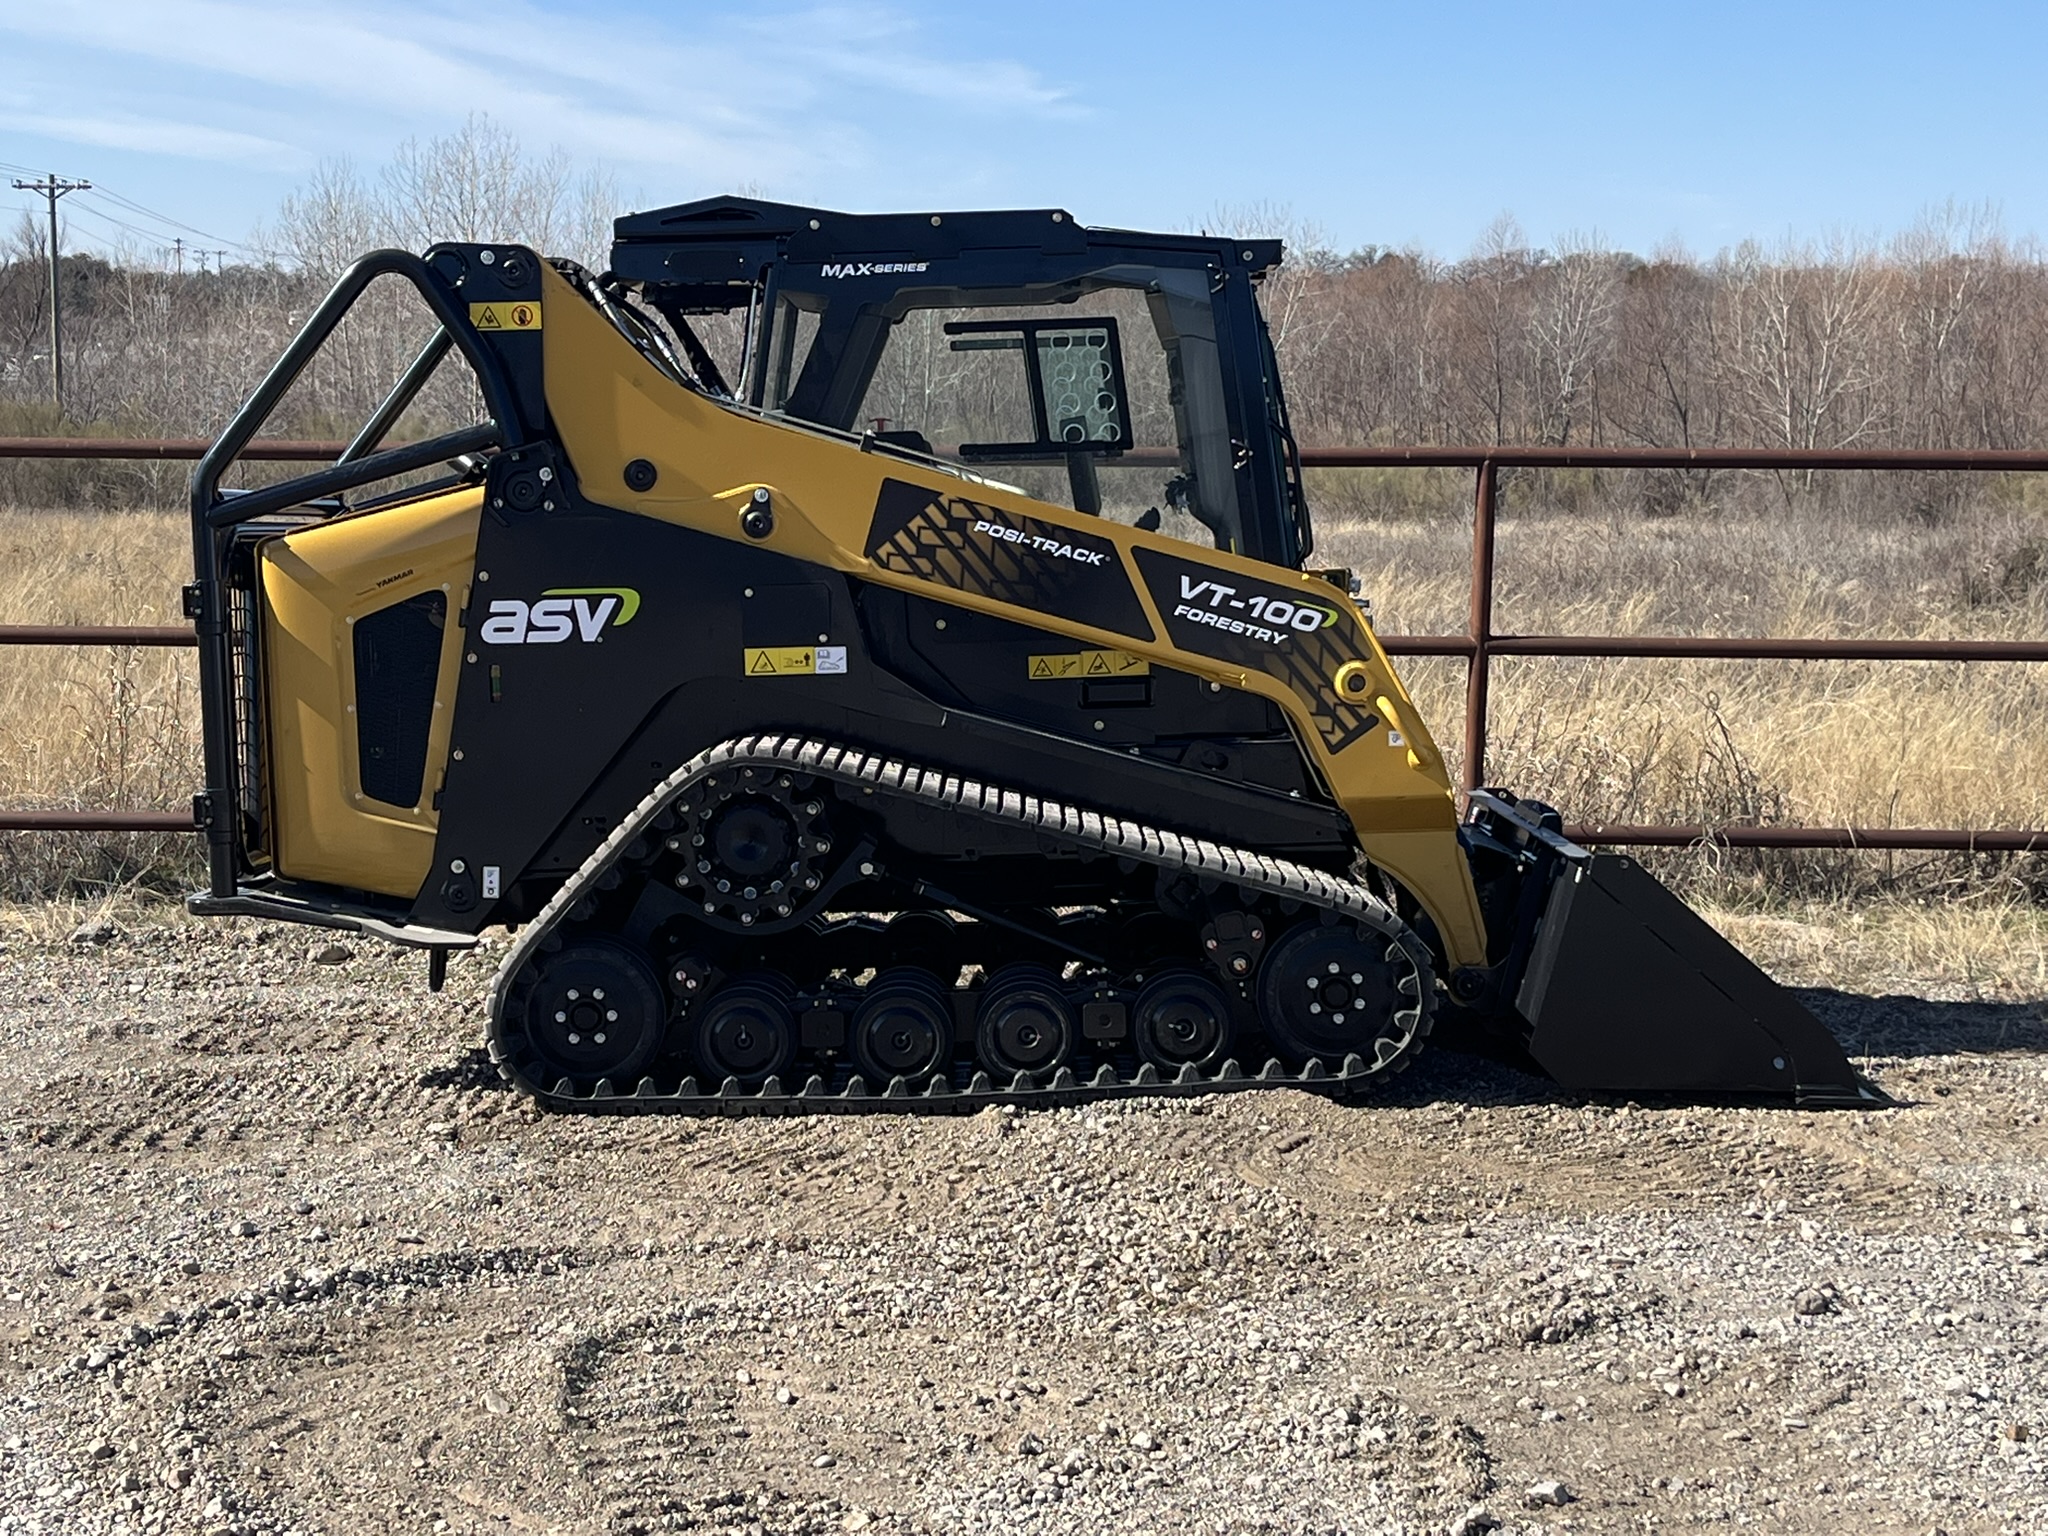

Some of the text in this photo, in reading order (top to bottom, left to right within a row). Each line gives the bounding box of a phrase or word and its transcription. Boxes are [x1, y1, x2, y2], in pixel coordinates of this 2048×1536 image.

[821, 262, 928, 279] MAX-SERIES
[973, 520, 1105, 567] POSI-TRACK
[376, 568, 414, 588] YANMAR
[1181, 575, 1323, 632] VT-100
[1173, 604, 1289, 645] FORESTRY
